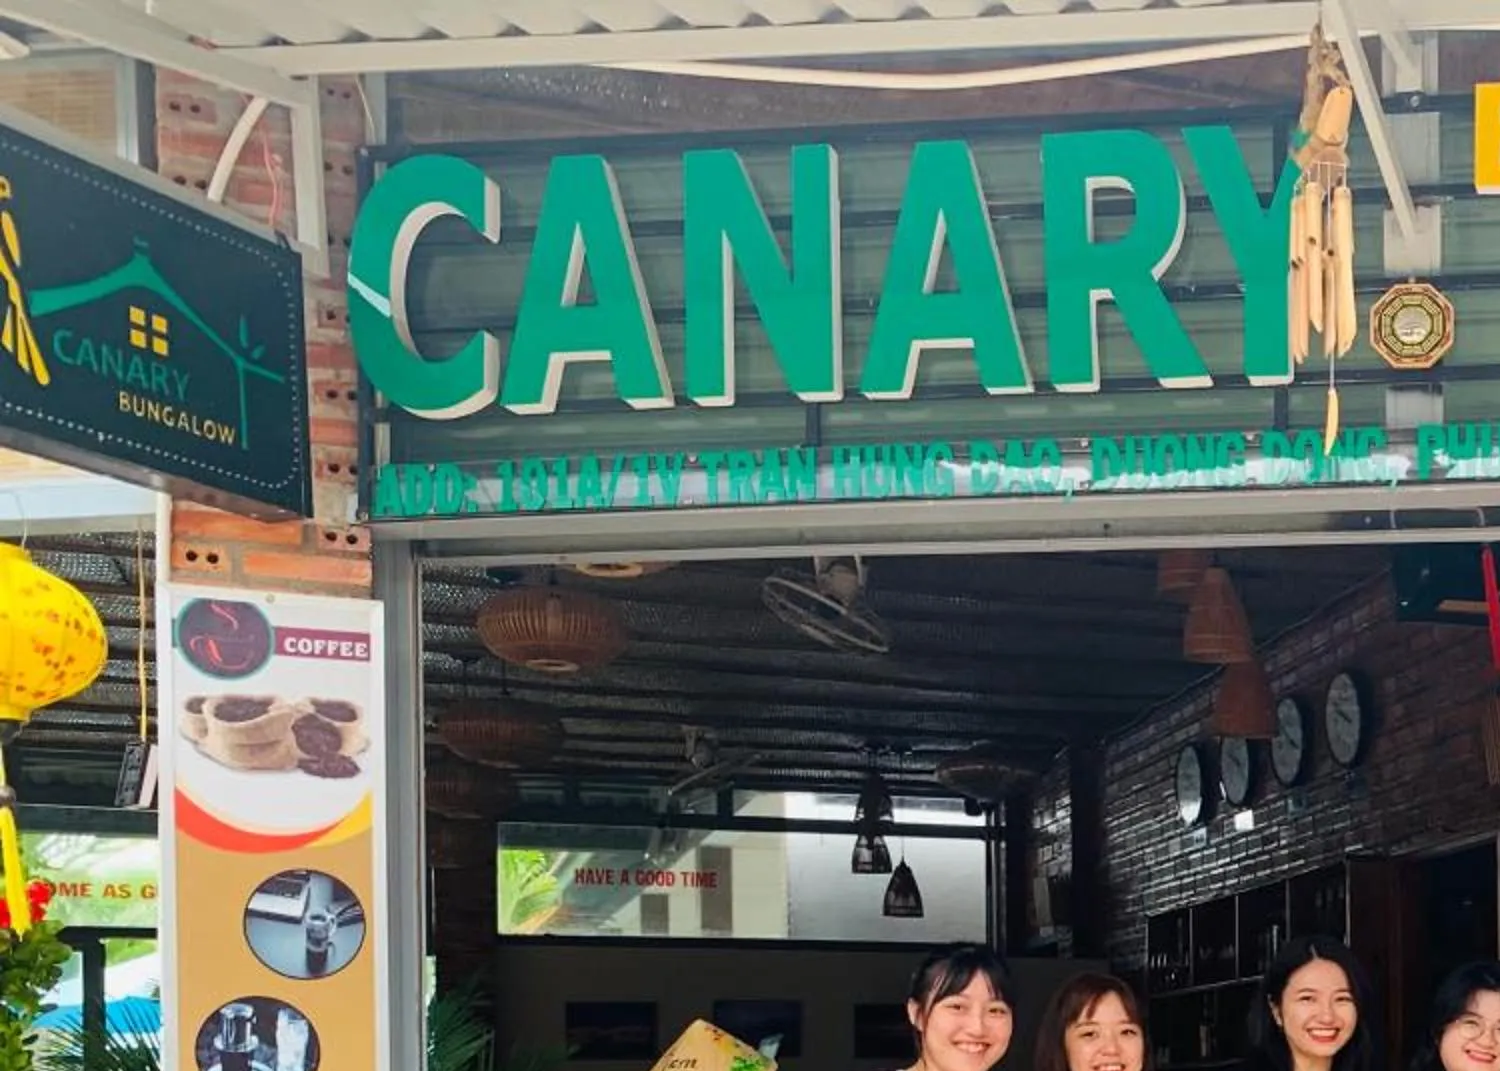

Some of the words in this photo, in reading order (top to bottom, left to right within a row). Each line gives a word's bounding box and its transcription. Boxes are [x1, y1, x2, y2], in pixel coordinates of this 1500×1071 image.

[347, 125, 1308, 420] CANARY
[53, 328, 191, 402] CANARY
[118, 390, 236, 446] BUNGALOW
[702, 446, 817, 506] TRAN
[833, 441, 952, 498] HUNG
[283, 636, 369, 658] COFFEE
[103, 883, 131, 899] AS
[575, 867, 614, 886] HAVE
[620, 869, 629, 886] A
[635, 868, 675, 888] GOOD
[681, 871, 717, 888] TIME
